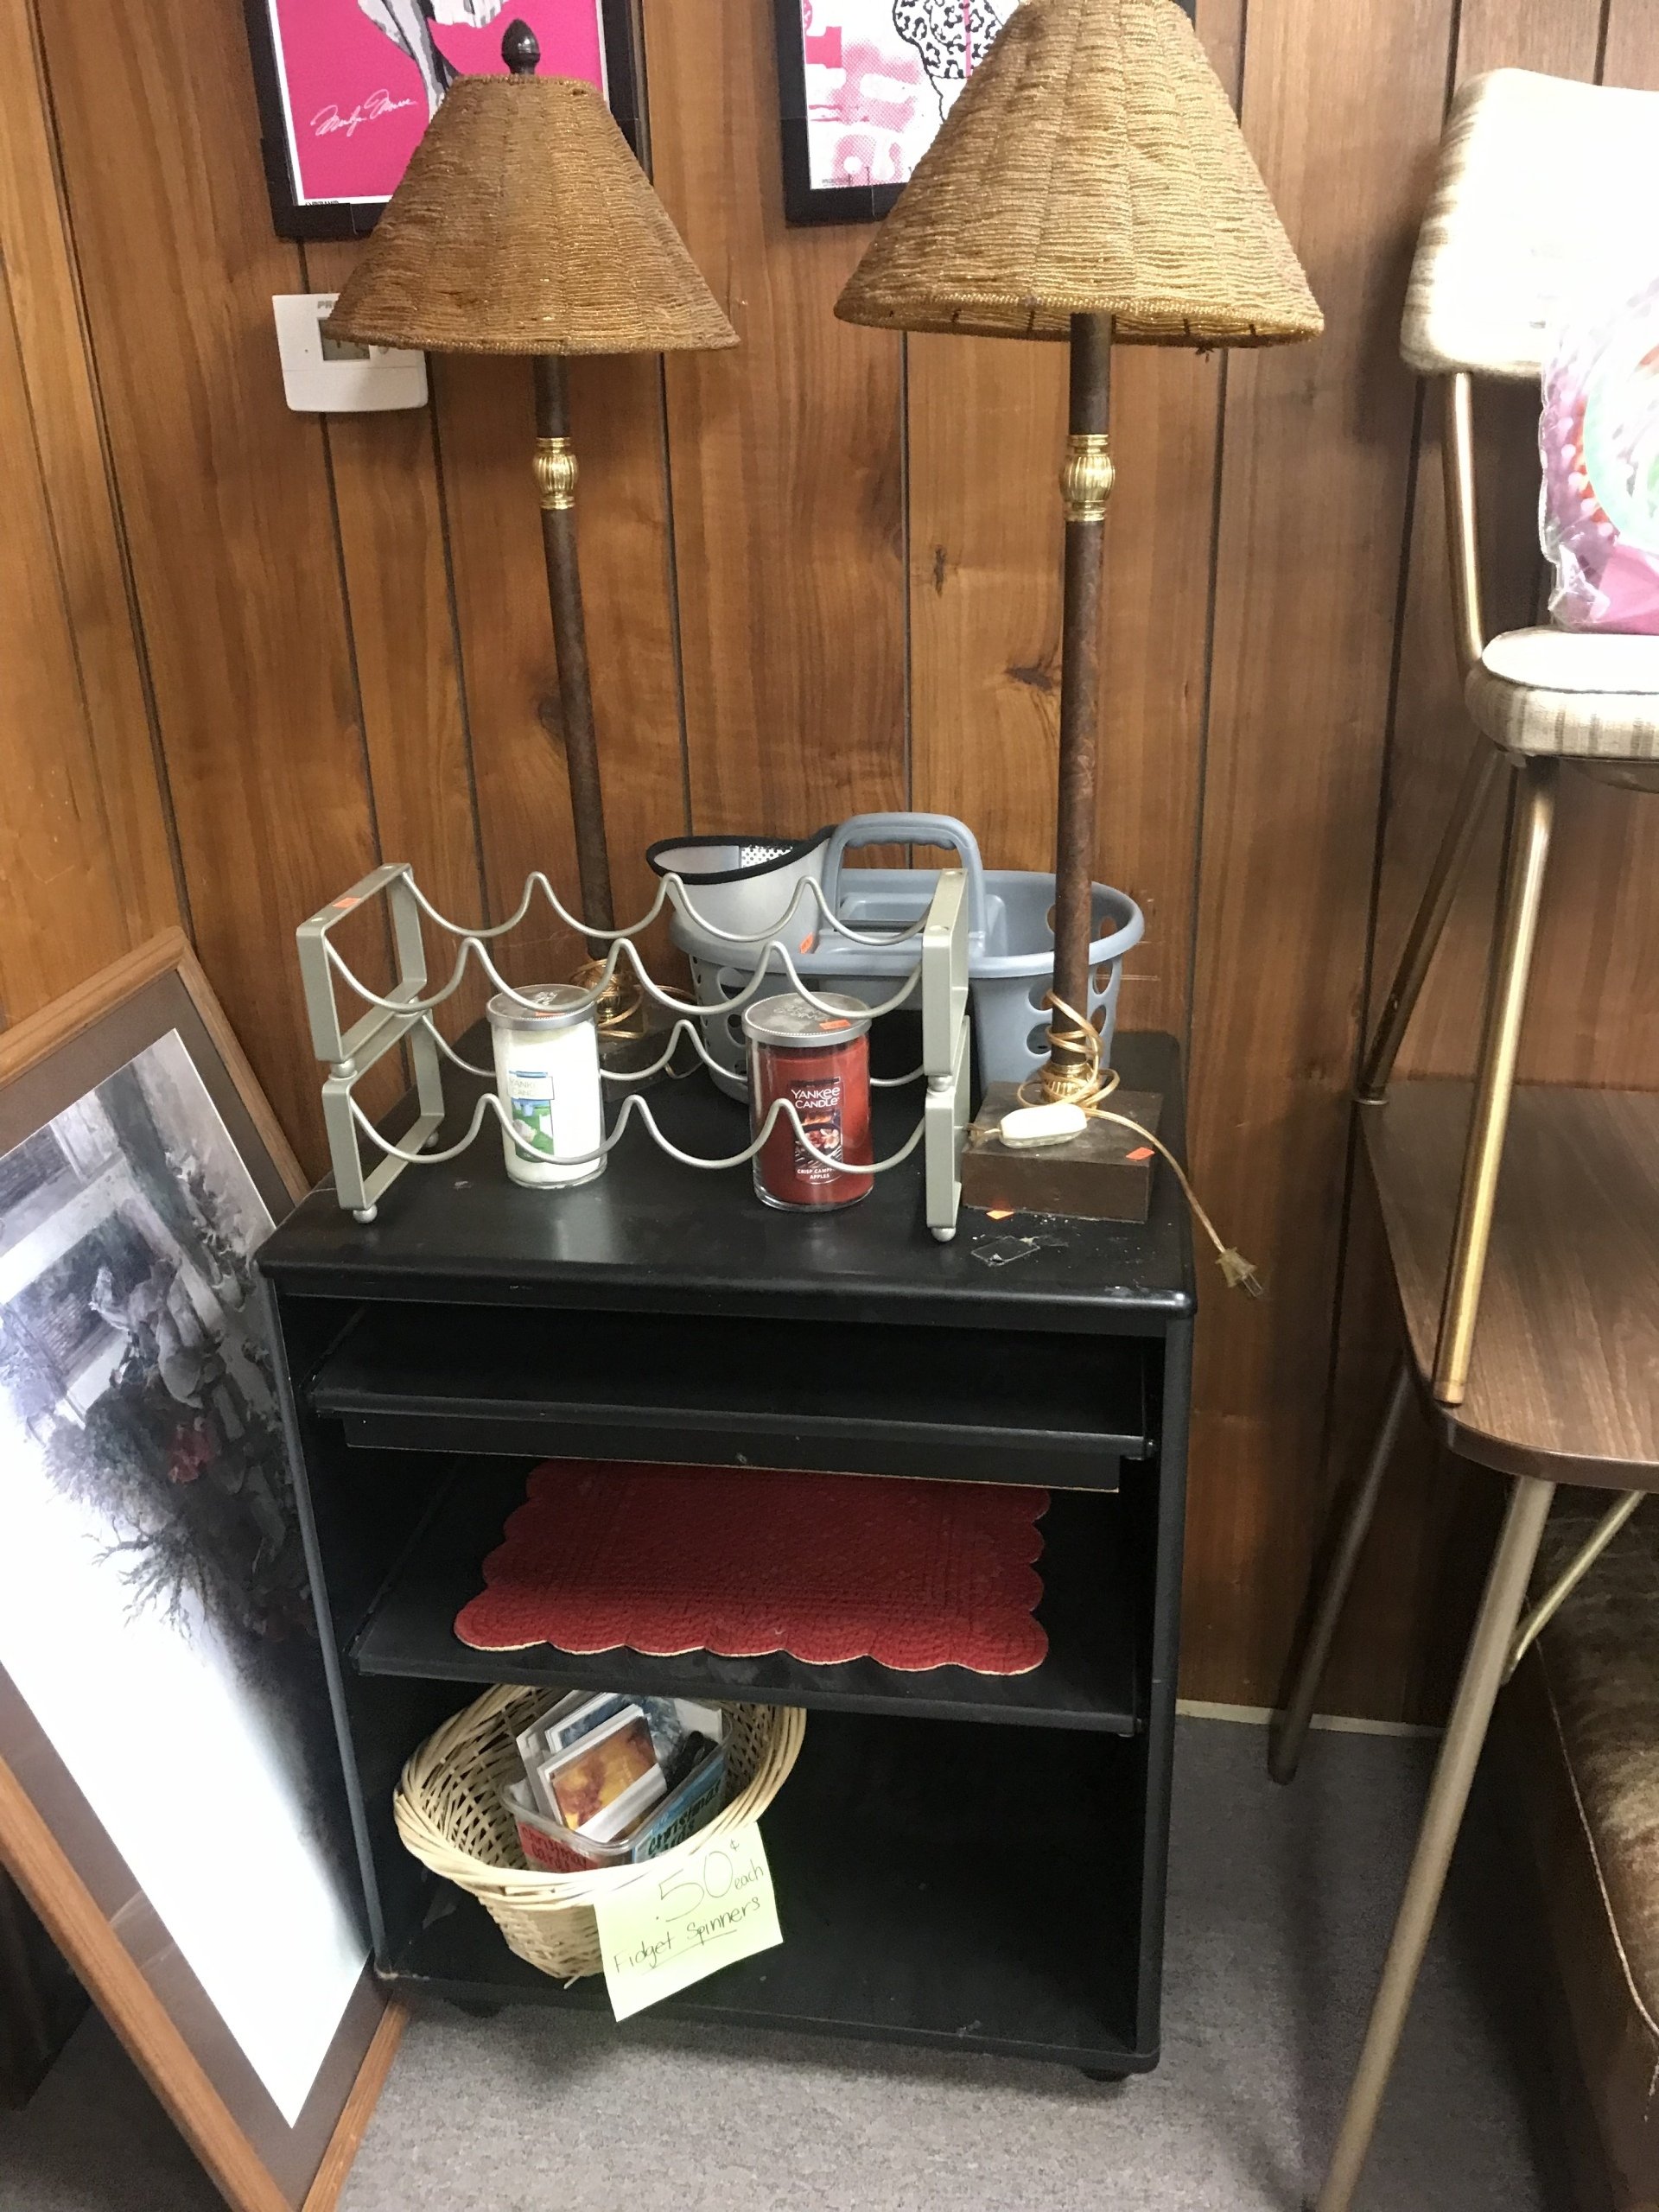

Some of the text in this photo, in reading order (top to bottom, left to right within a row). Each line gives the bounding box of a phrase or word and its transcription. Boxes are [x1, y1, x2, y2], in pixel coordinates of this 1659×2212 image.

[734, 1859, 765, 1891] each
[613, 1896, 761, 1970] Fidget Spinners
